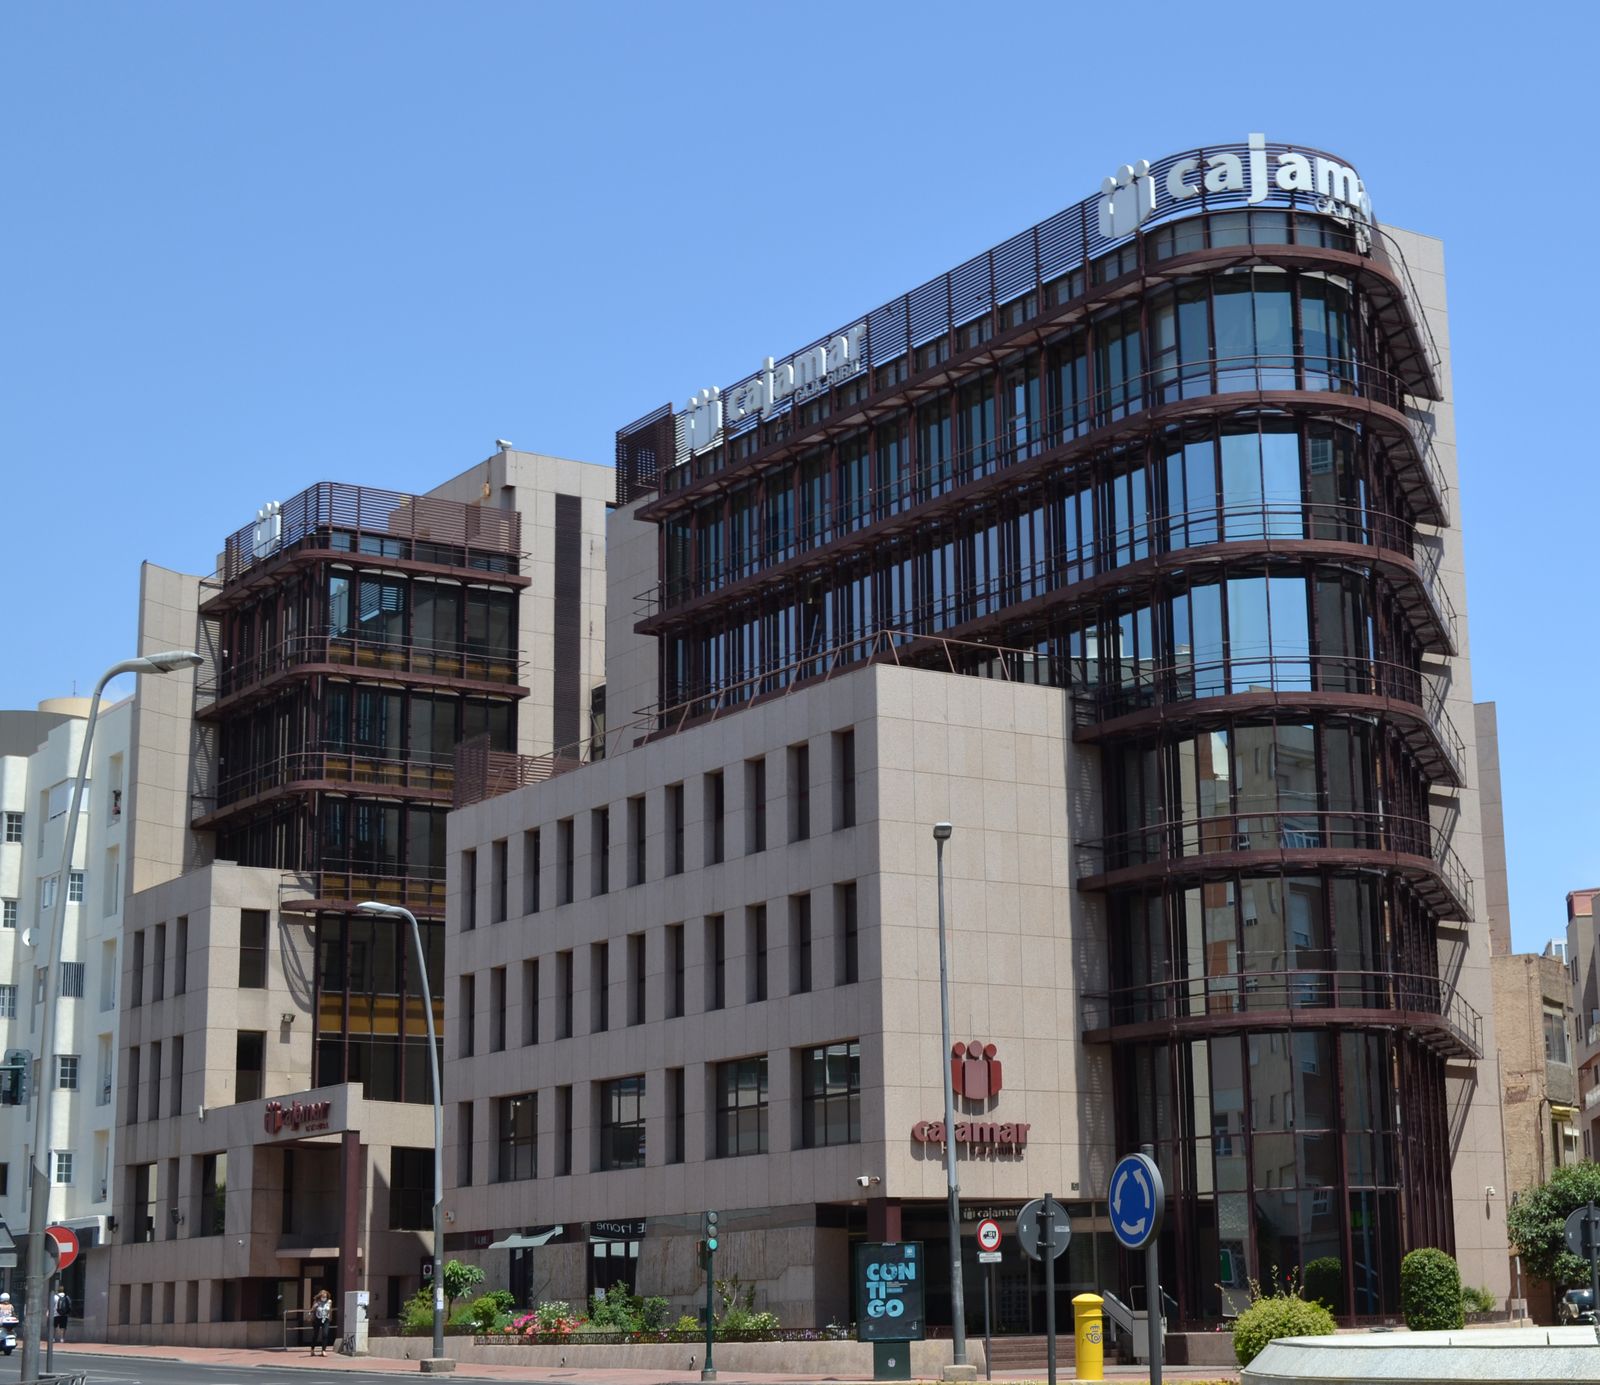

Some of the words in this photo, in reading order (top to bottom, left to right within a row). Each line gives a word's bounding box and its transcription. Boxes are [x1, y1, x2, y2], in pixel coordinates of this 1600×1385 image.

[726, 324, 867, 421] cajamar
[911, 1120, 1031, 1144] caamar
[977, 1207, 1020, 1218] cajamar
[866, 1262, 916, 1281] CON
[866, 1281, 886, 1299] TI
[866, 1298, 905, 1318] GO
